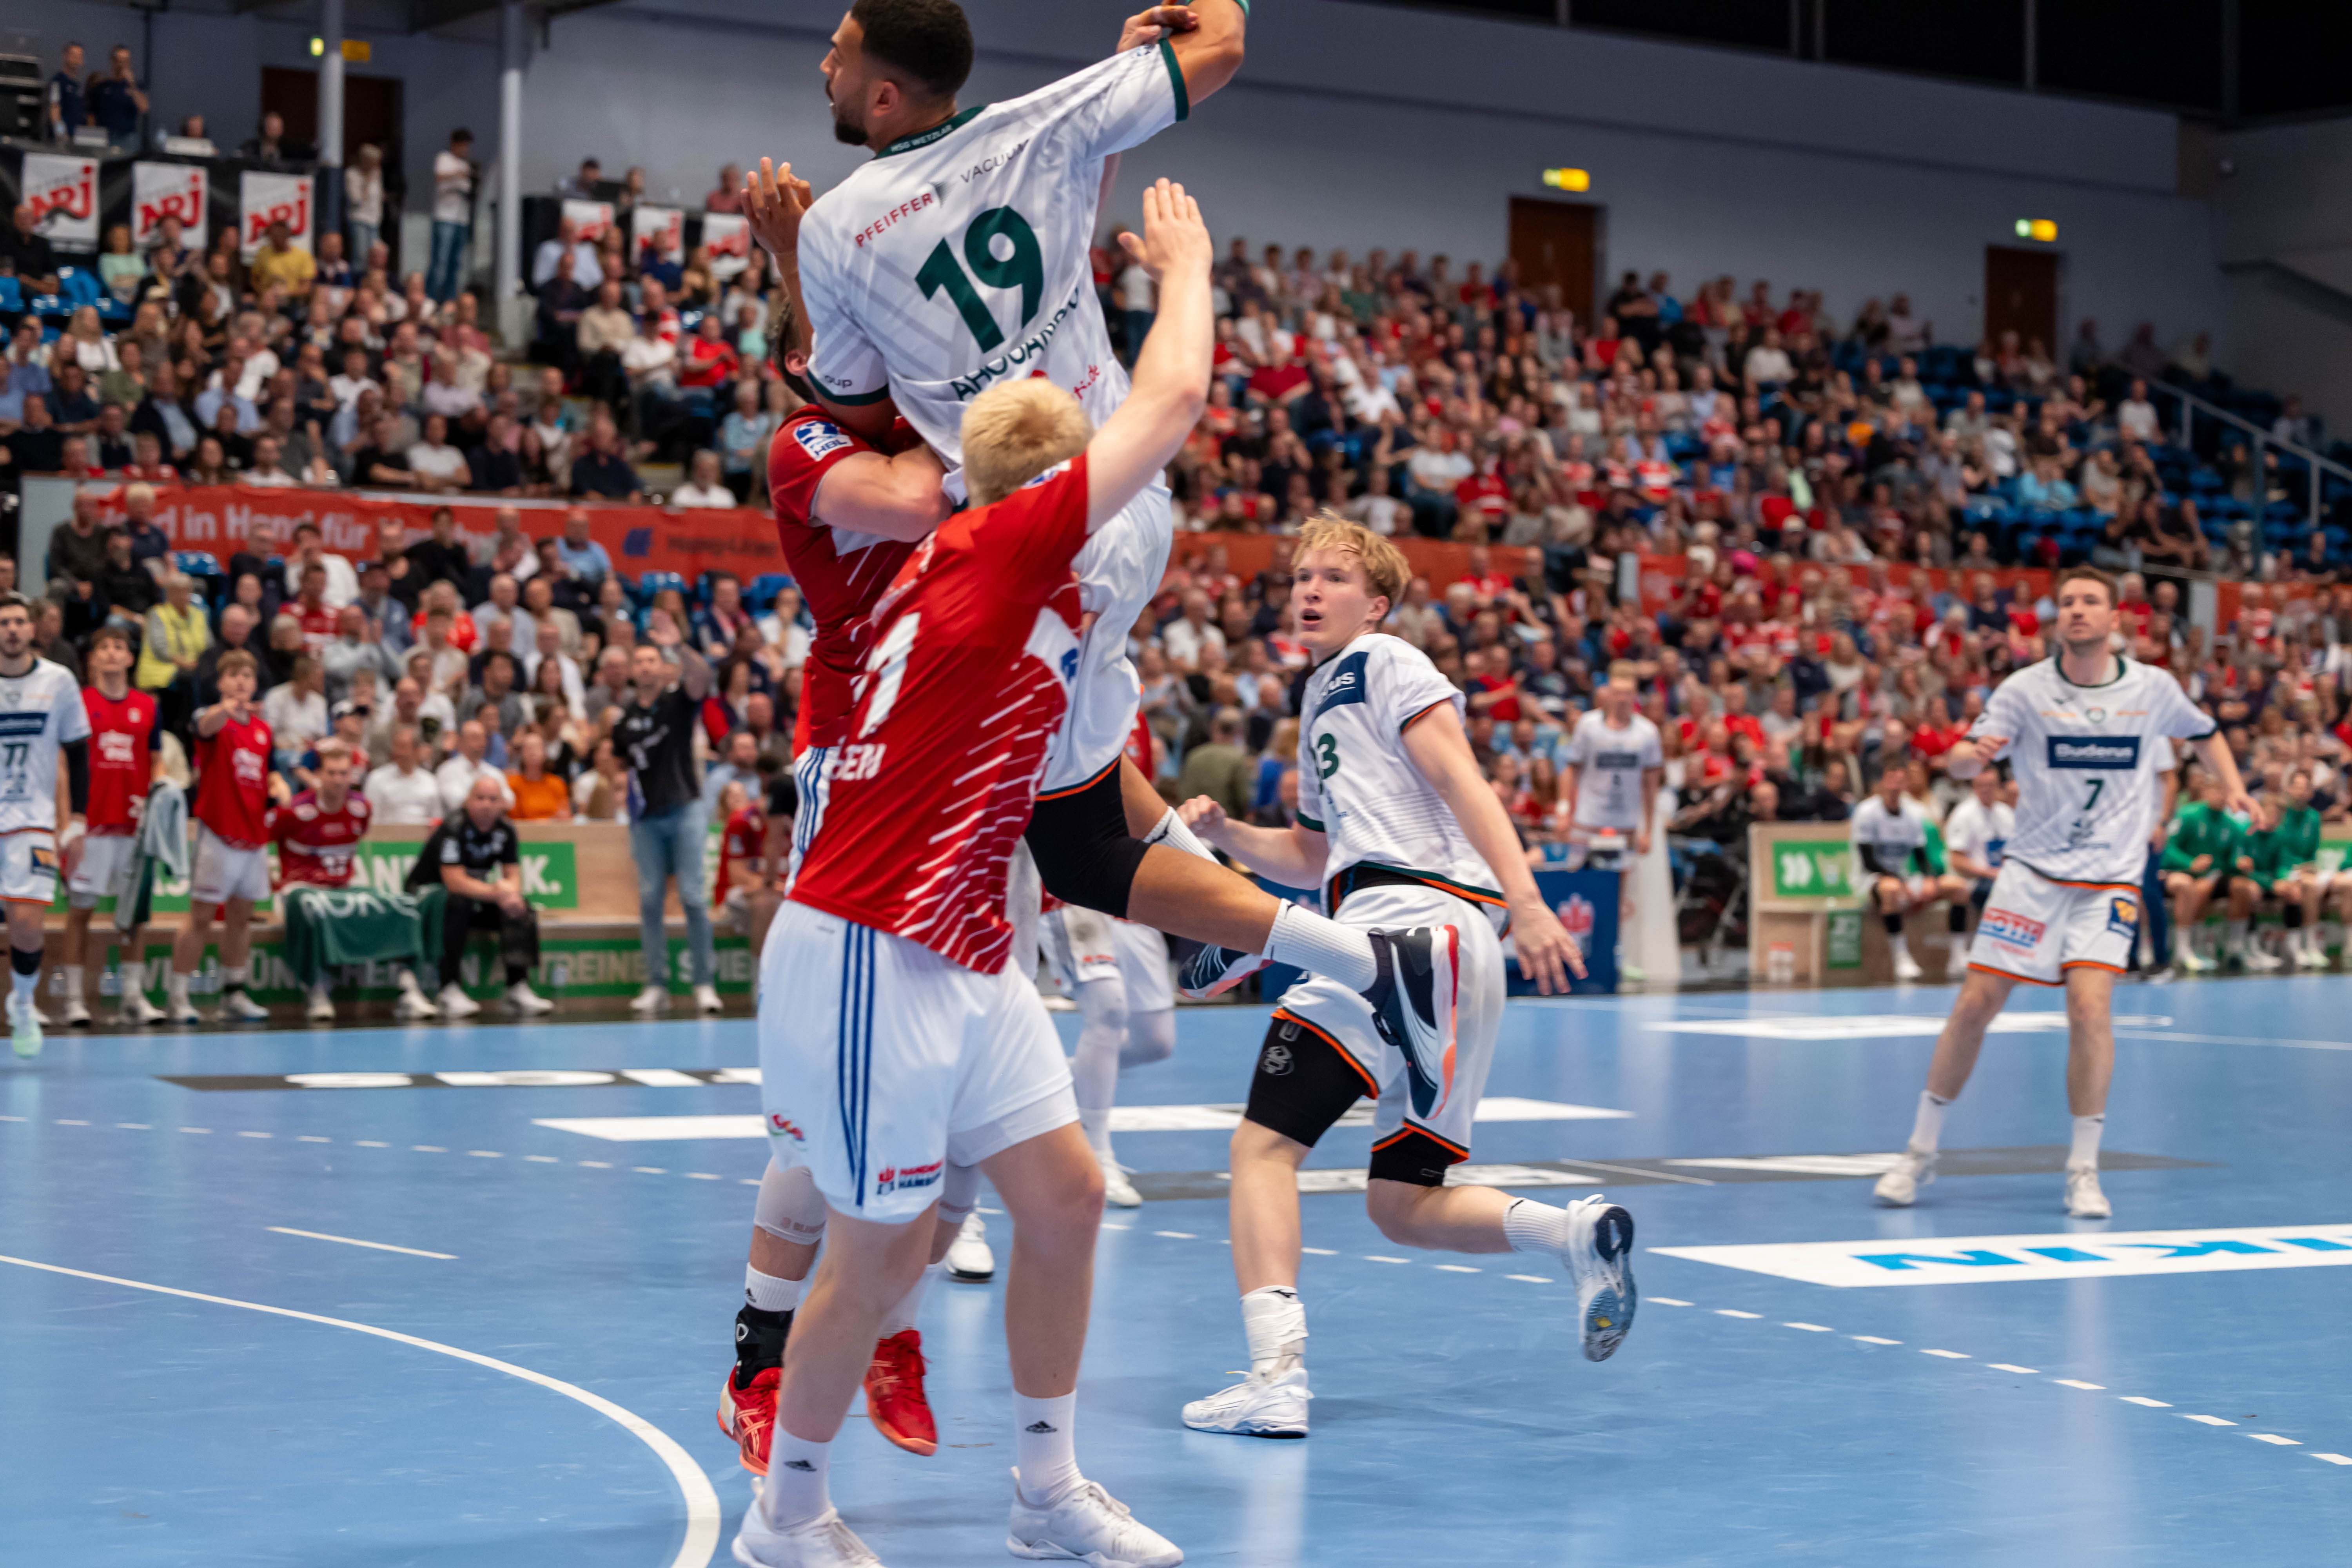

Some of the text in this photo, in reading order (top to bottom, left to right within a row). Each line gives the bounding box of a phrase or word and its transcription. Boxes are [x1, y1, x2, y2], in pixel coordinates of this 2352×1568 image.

[855, 192, 934, 248] PFEIFFER
[915, 205, 1044, 354] 19
[814, 439, 848, 456] HBL
[2083, 778, 2104, 810] 7
[1851, 1236, 2352, 1271] IKIN
